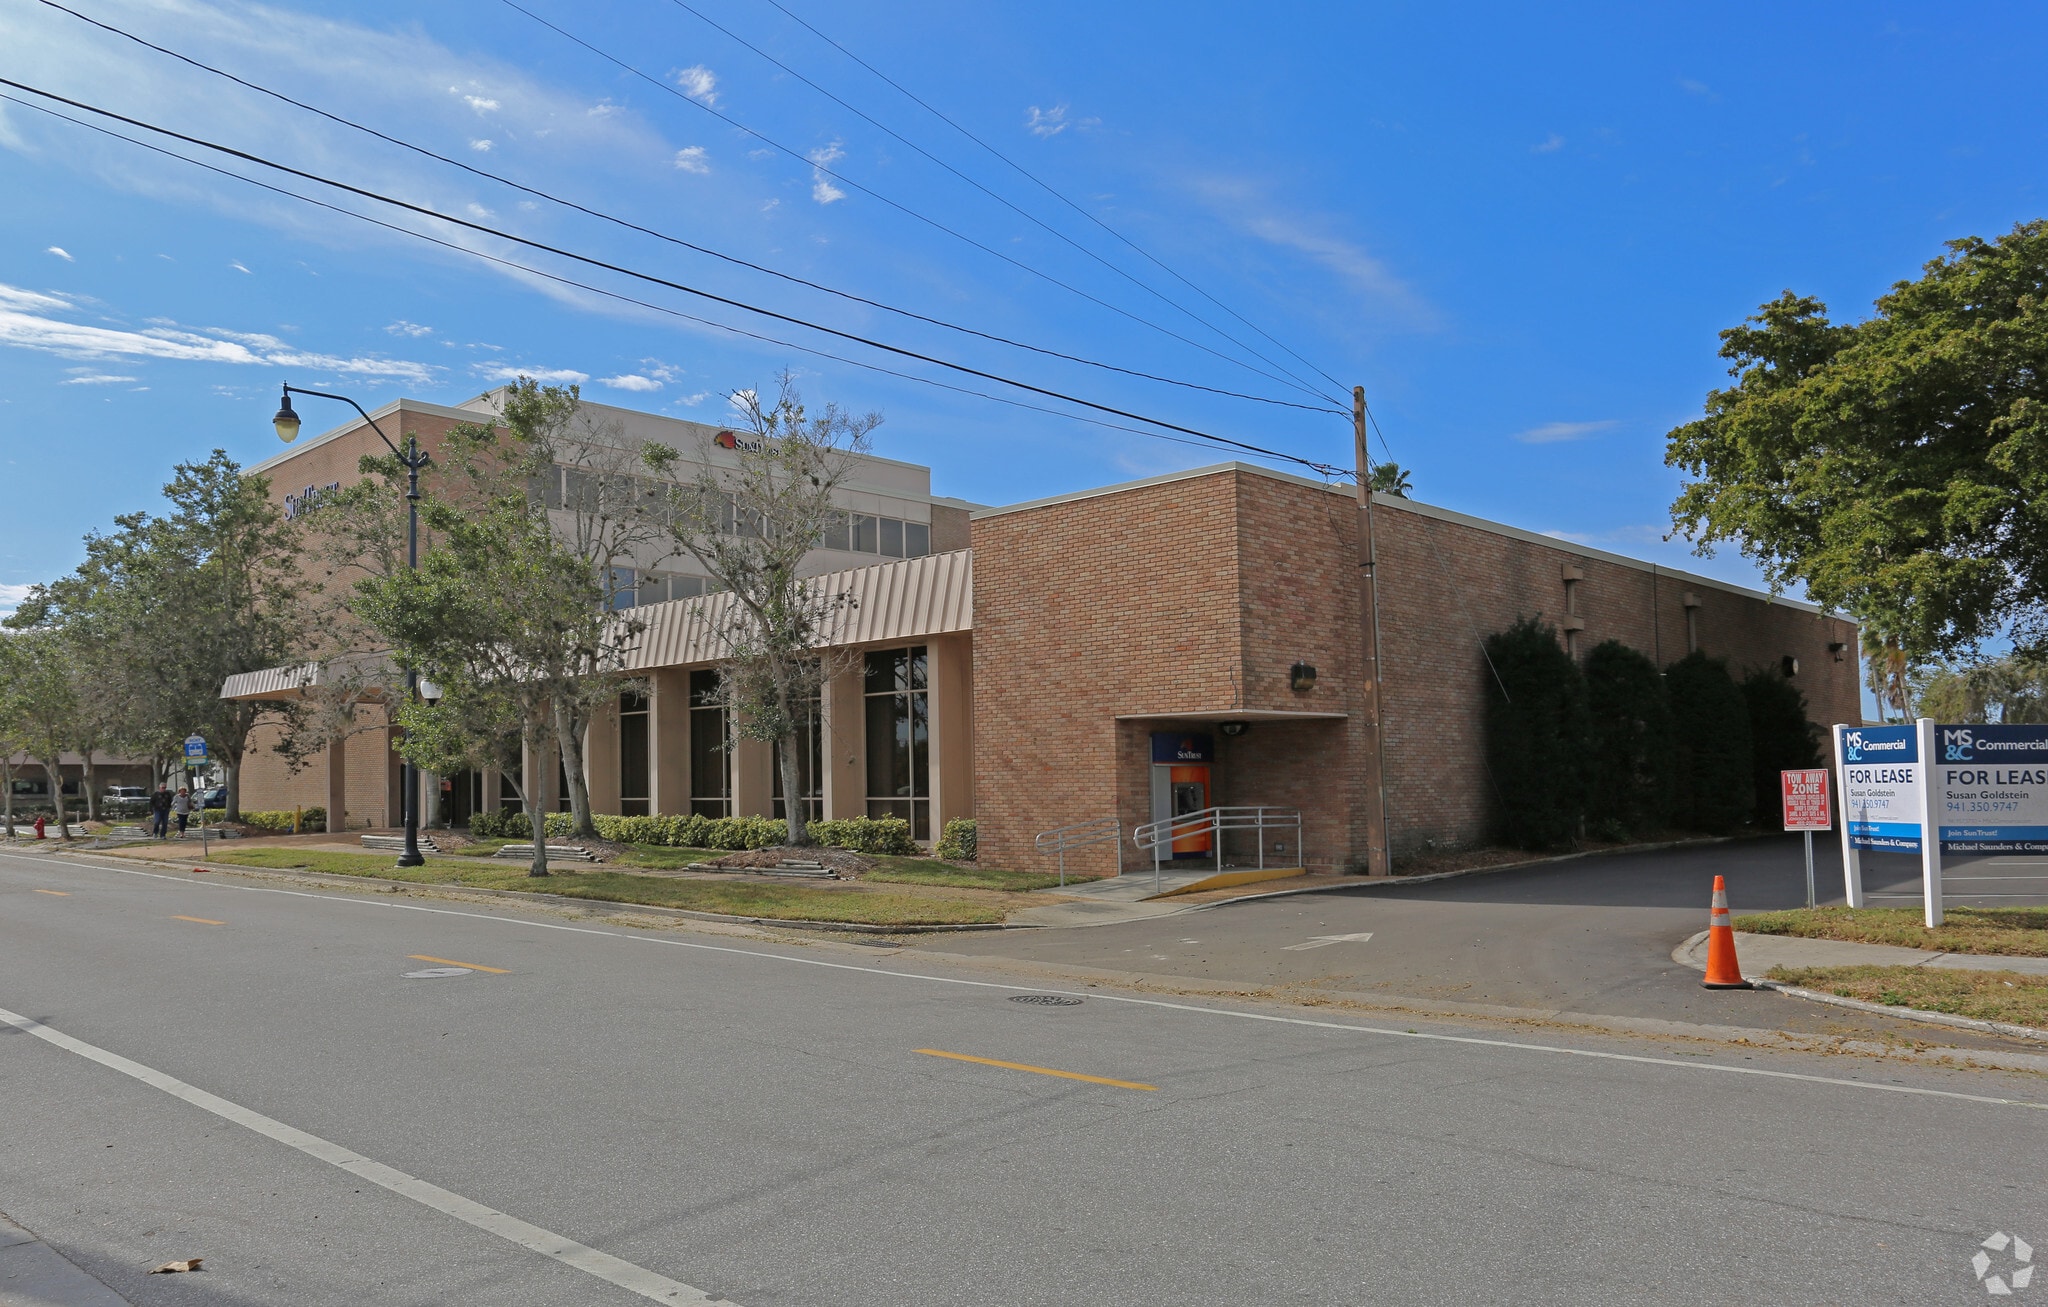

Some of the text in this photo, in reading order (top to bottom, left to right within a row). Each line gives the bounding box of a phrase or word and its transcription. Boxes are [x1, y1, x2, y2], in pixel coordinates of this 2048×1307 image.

[1846, 731, 1862, 747] MS
[1944, 729, 1973, 745] MS
[1862, 739, 1906, 751] Commercial
[1976, 739, 2048, 750] Commercial
[1847, 746, 1862, 761] &C
[1945, 744, 1973, 760] &C
[1787, 773, 1824, 784] TOW AWAY
[1849, 769, 1913, 784] FOR LEASE
[1947, 770, 2048, 785] FOR LEAS
[1792, 784, 1820, 794] ZONE
[1867, 789, 1896, 797] Goldstein
[1946, 791, 2029, 799] Susan Goldstein
[1946, 802, 2018, 812] 941.350.9747
[1890, 839, 1896, 847] &
[1947, 842, 1977, 851] Michael
[1979, 842, 2013, 851] Saunders
[2014, 842, 2023, 850] &
